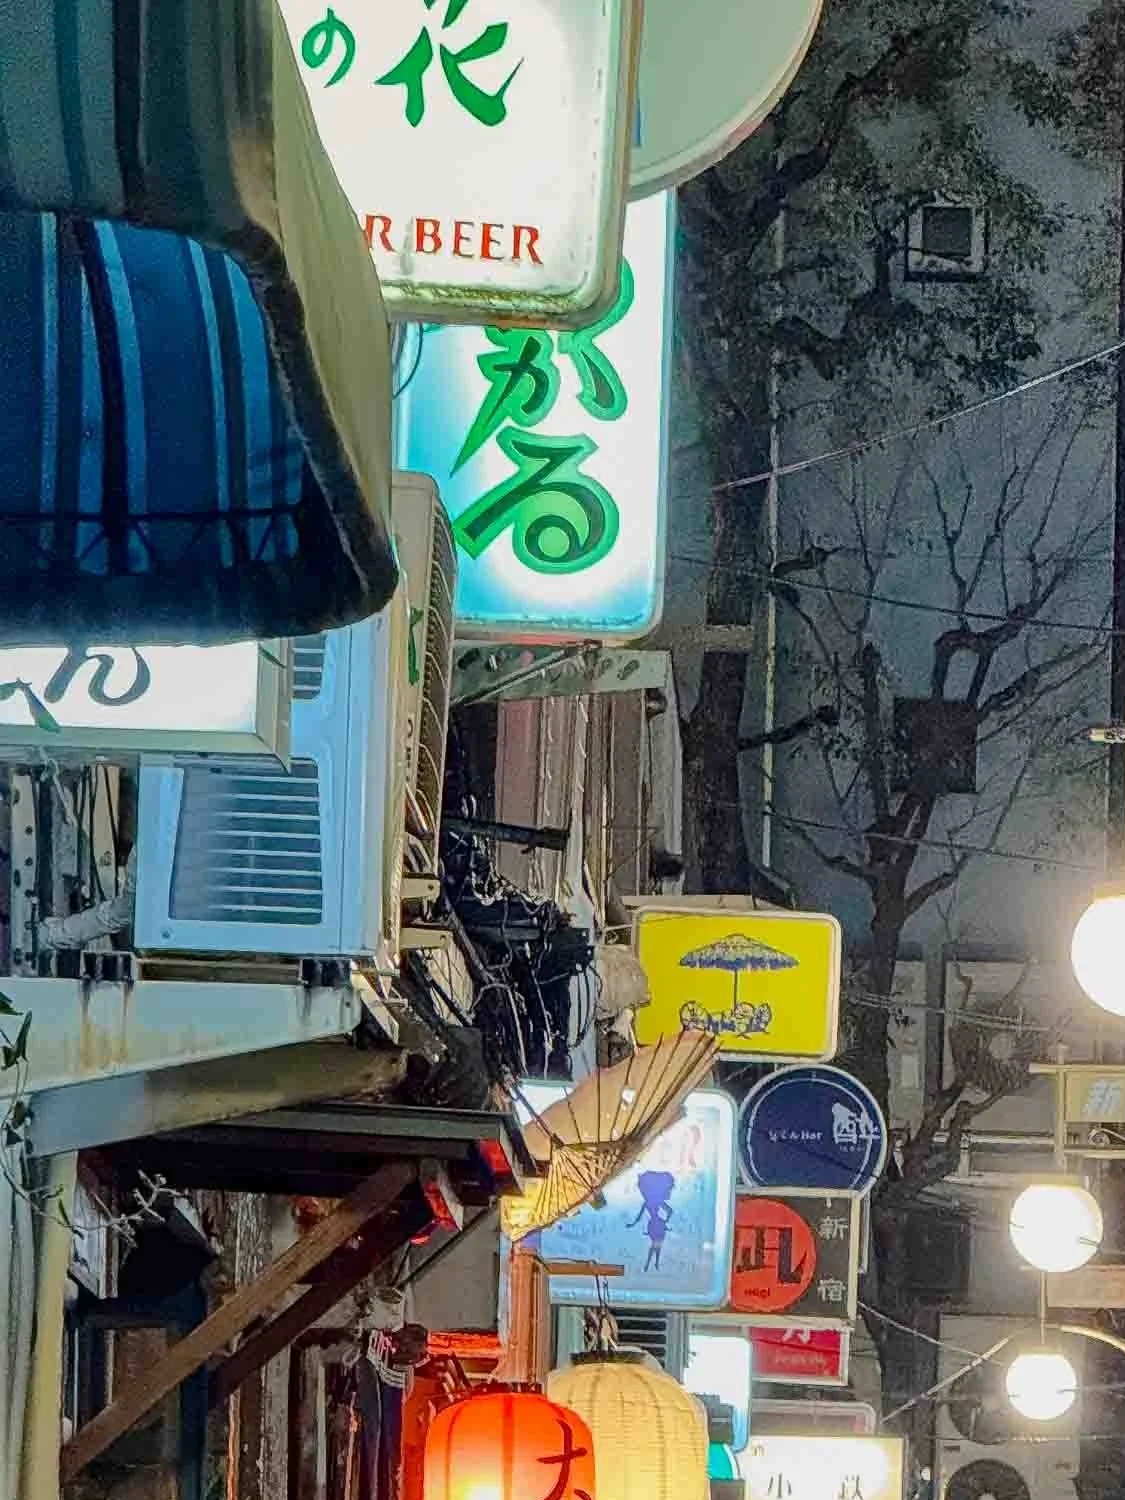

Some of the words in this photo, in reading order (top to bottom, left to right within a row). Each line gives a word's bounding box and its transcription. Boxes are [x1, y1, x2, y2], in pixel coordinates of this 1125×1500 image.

[415, 217, 544, 264] BEER
[450, 260, 634, 575] かる
[817, 1216, 848, 1302] 新宿
